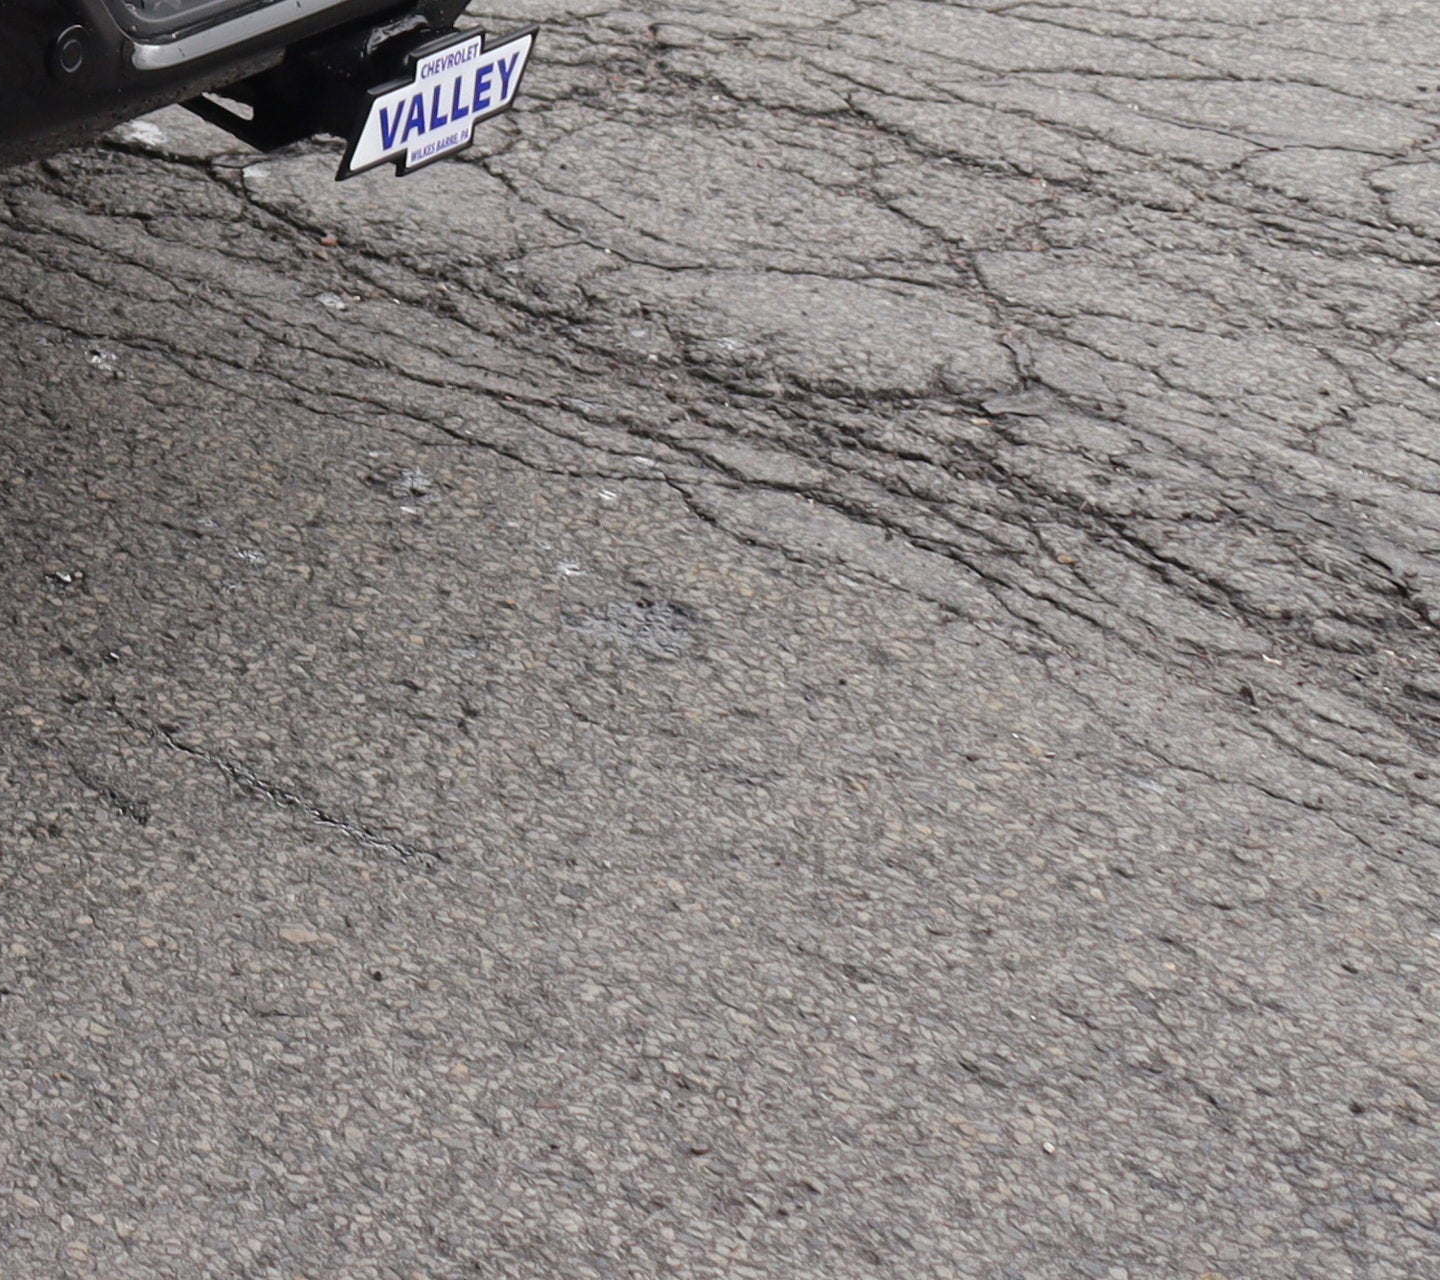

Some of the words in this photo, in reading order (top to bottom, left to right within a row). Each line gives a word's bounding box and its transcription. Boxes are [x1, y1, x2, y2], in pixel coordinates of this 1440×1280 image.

[420, 43, 479, 79] CHEVROLET
[379, 51, 520, 151] VALLEY
[410, 142, 436, 162] WILKES
[460, 128, 469, 139] PA
